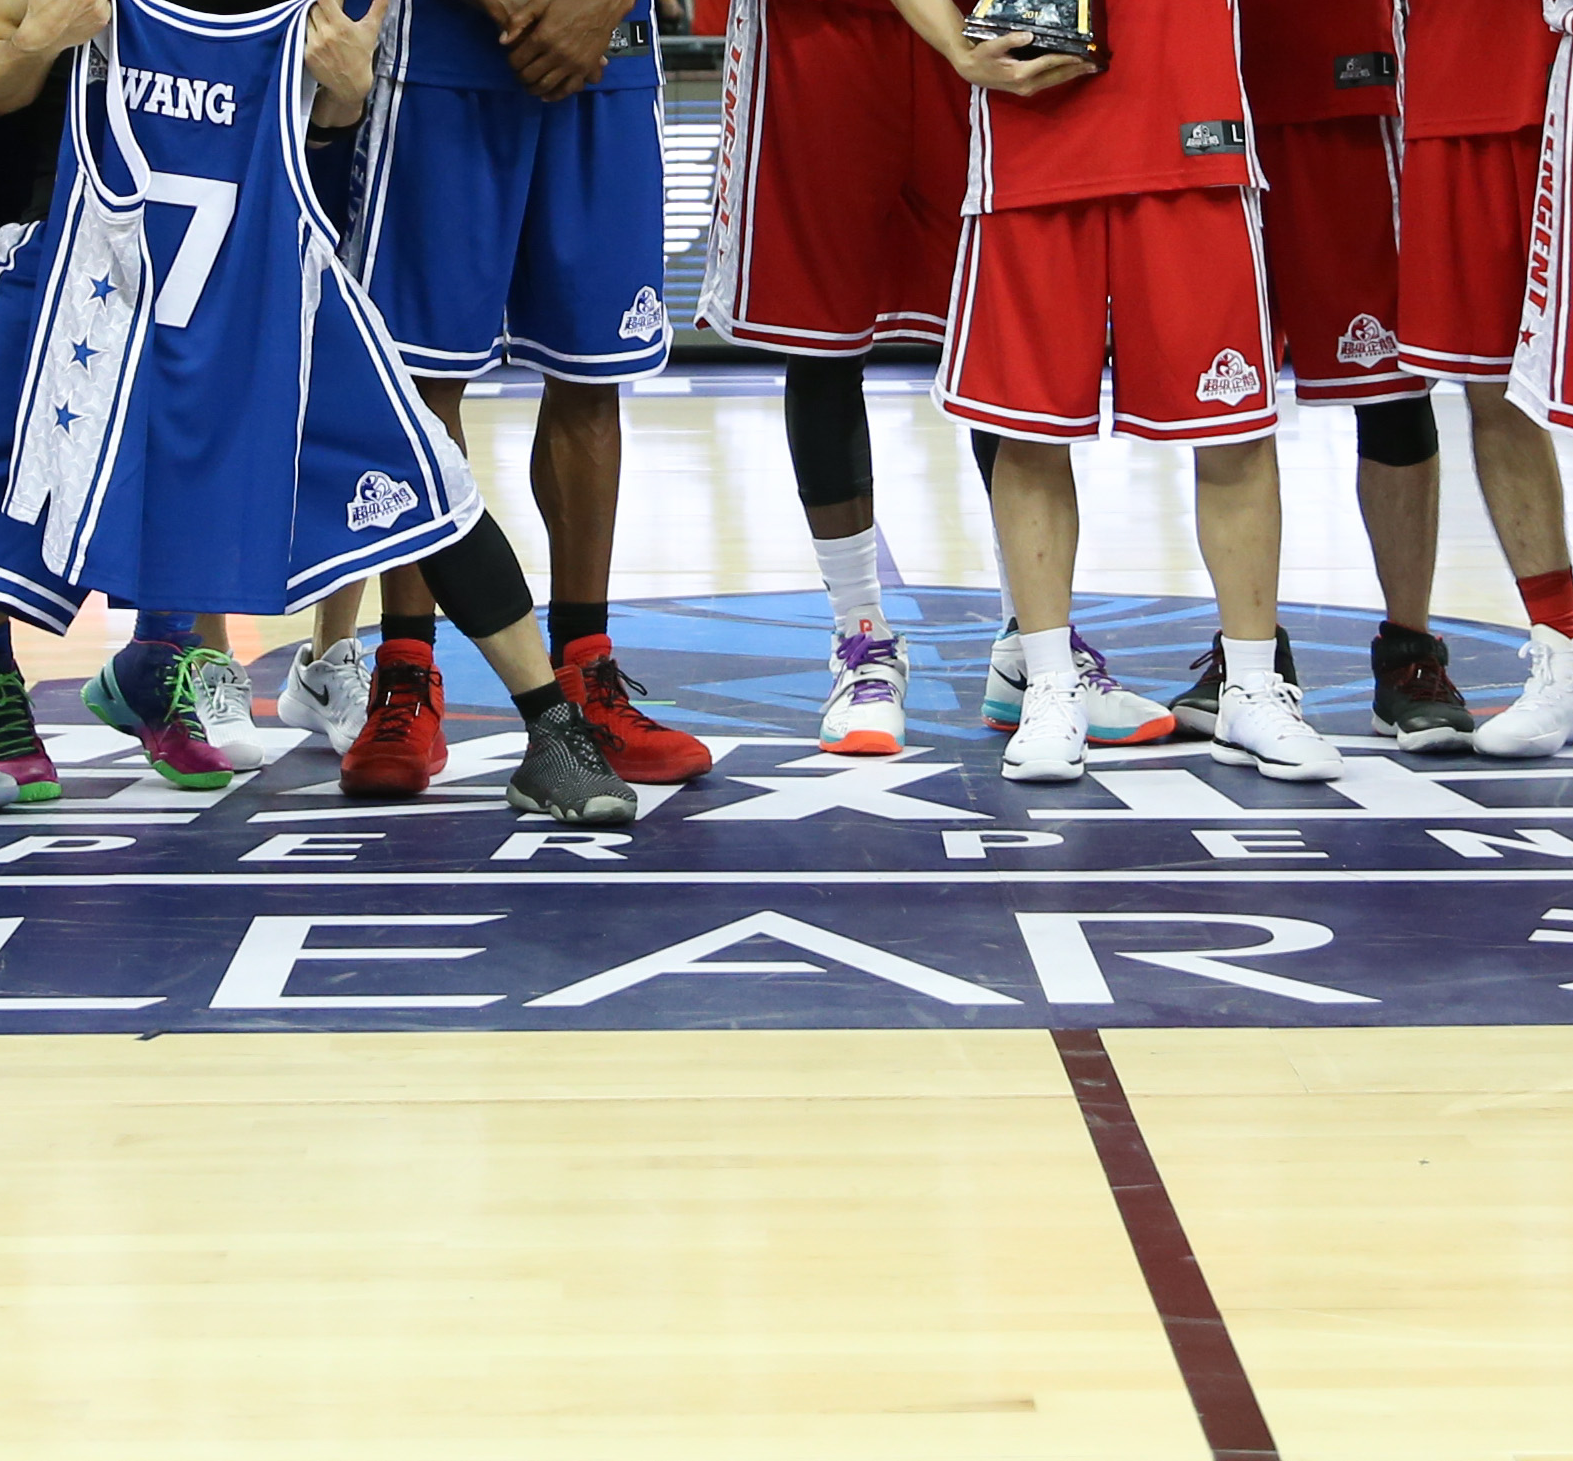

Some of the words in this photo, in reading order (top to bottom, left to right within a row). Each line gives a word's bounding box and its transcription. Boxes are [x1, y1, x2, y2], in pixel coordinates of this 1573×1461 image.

[636, 26, 644, 43] L
[1383, 57, 1390, 74] L
[119, 66, 236, 126] WANG
[1231, 123, 1244, 143] L
[1528, 112, 1555, 317] ENCENT
[141, 170, 238, 328] 7
